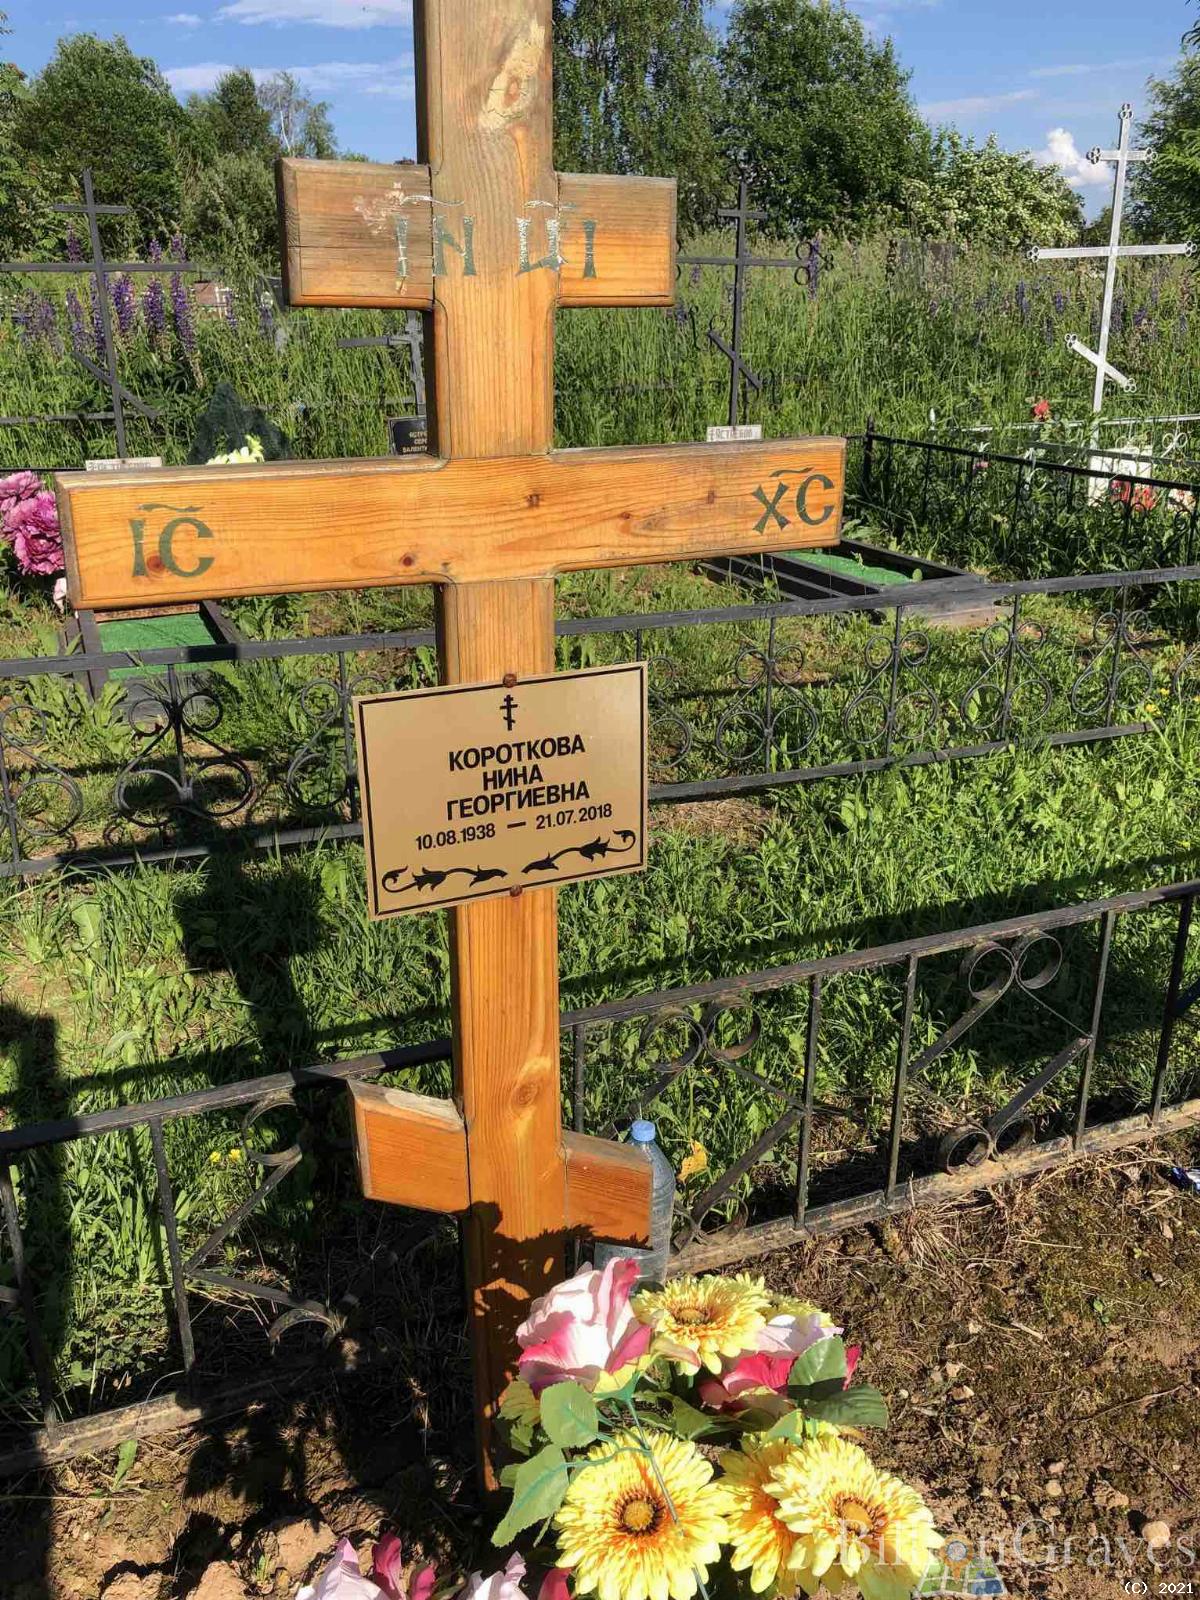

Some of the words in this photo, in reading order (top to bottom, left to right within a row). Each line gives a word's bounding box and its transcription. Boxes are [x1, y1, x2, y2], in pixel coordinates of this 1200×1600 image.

[449, 734, 586, 772] КОРОТКОВА
[482, 764, 544, 791] НИНА
[446, 781, 590, 820] ГЕОРГИЕВНА
[415, 823, 496, 850] 10.08.1938
[535, 803, 612, 830] 21.07.2018
